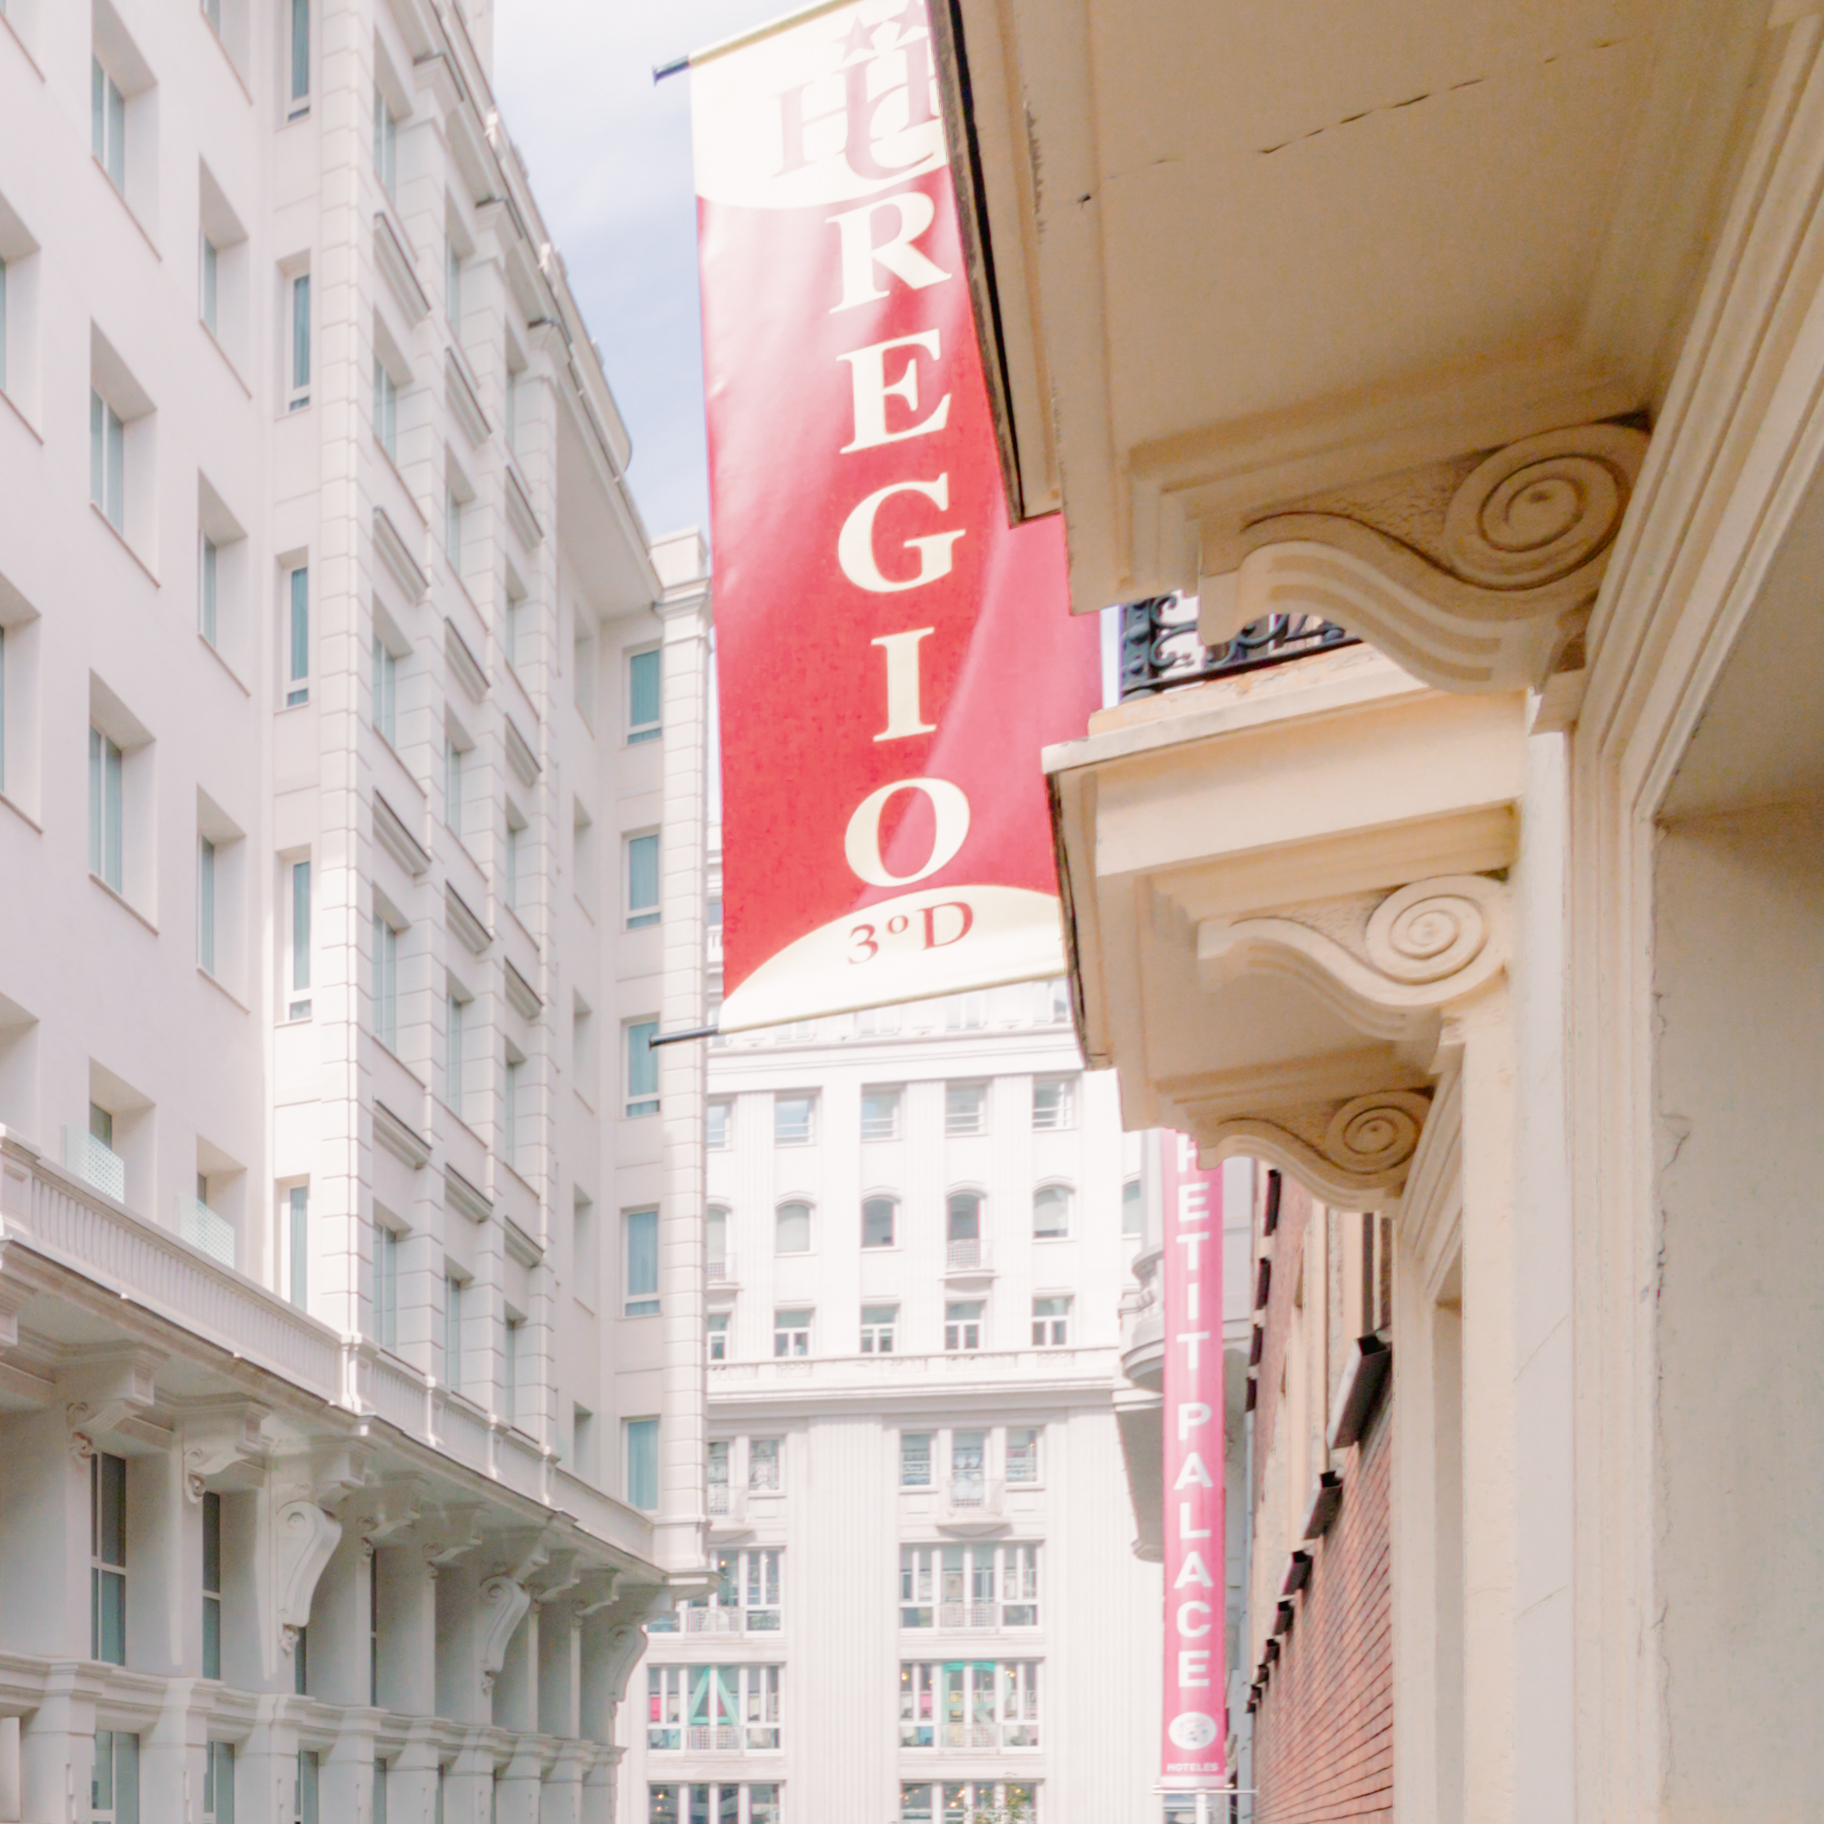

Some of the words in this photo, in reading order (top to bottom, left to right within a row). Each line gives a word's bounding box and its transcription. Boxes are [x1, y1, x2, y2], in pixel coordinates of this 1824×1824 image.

[825, 191, 971, 888] REGIO
[1173, 1402, 1214, 1688] PALACE
[1167, 1762, 1219, 1773] HOTELES
